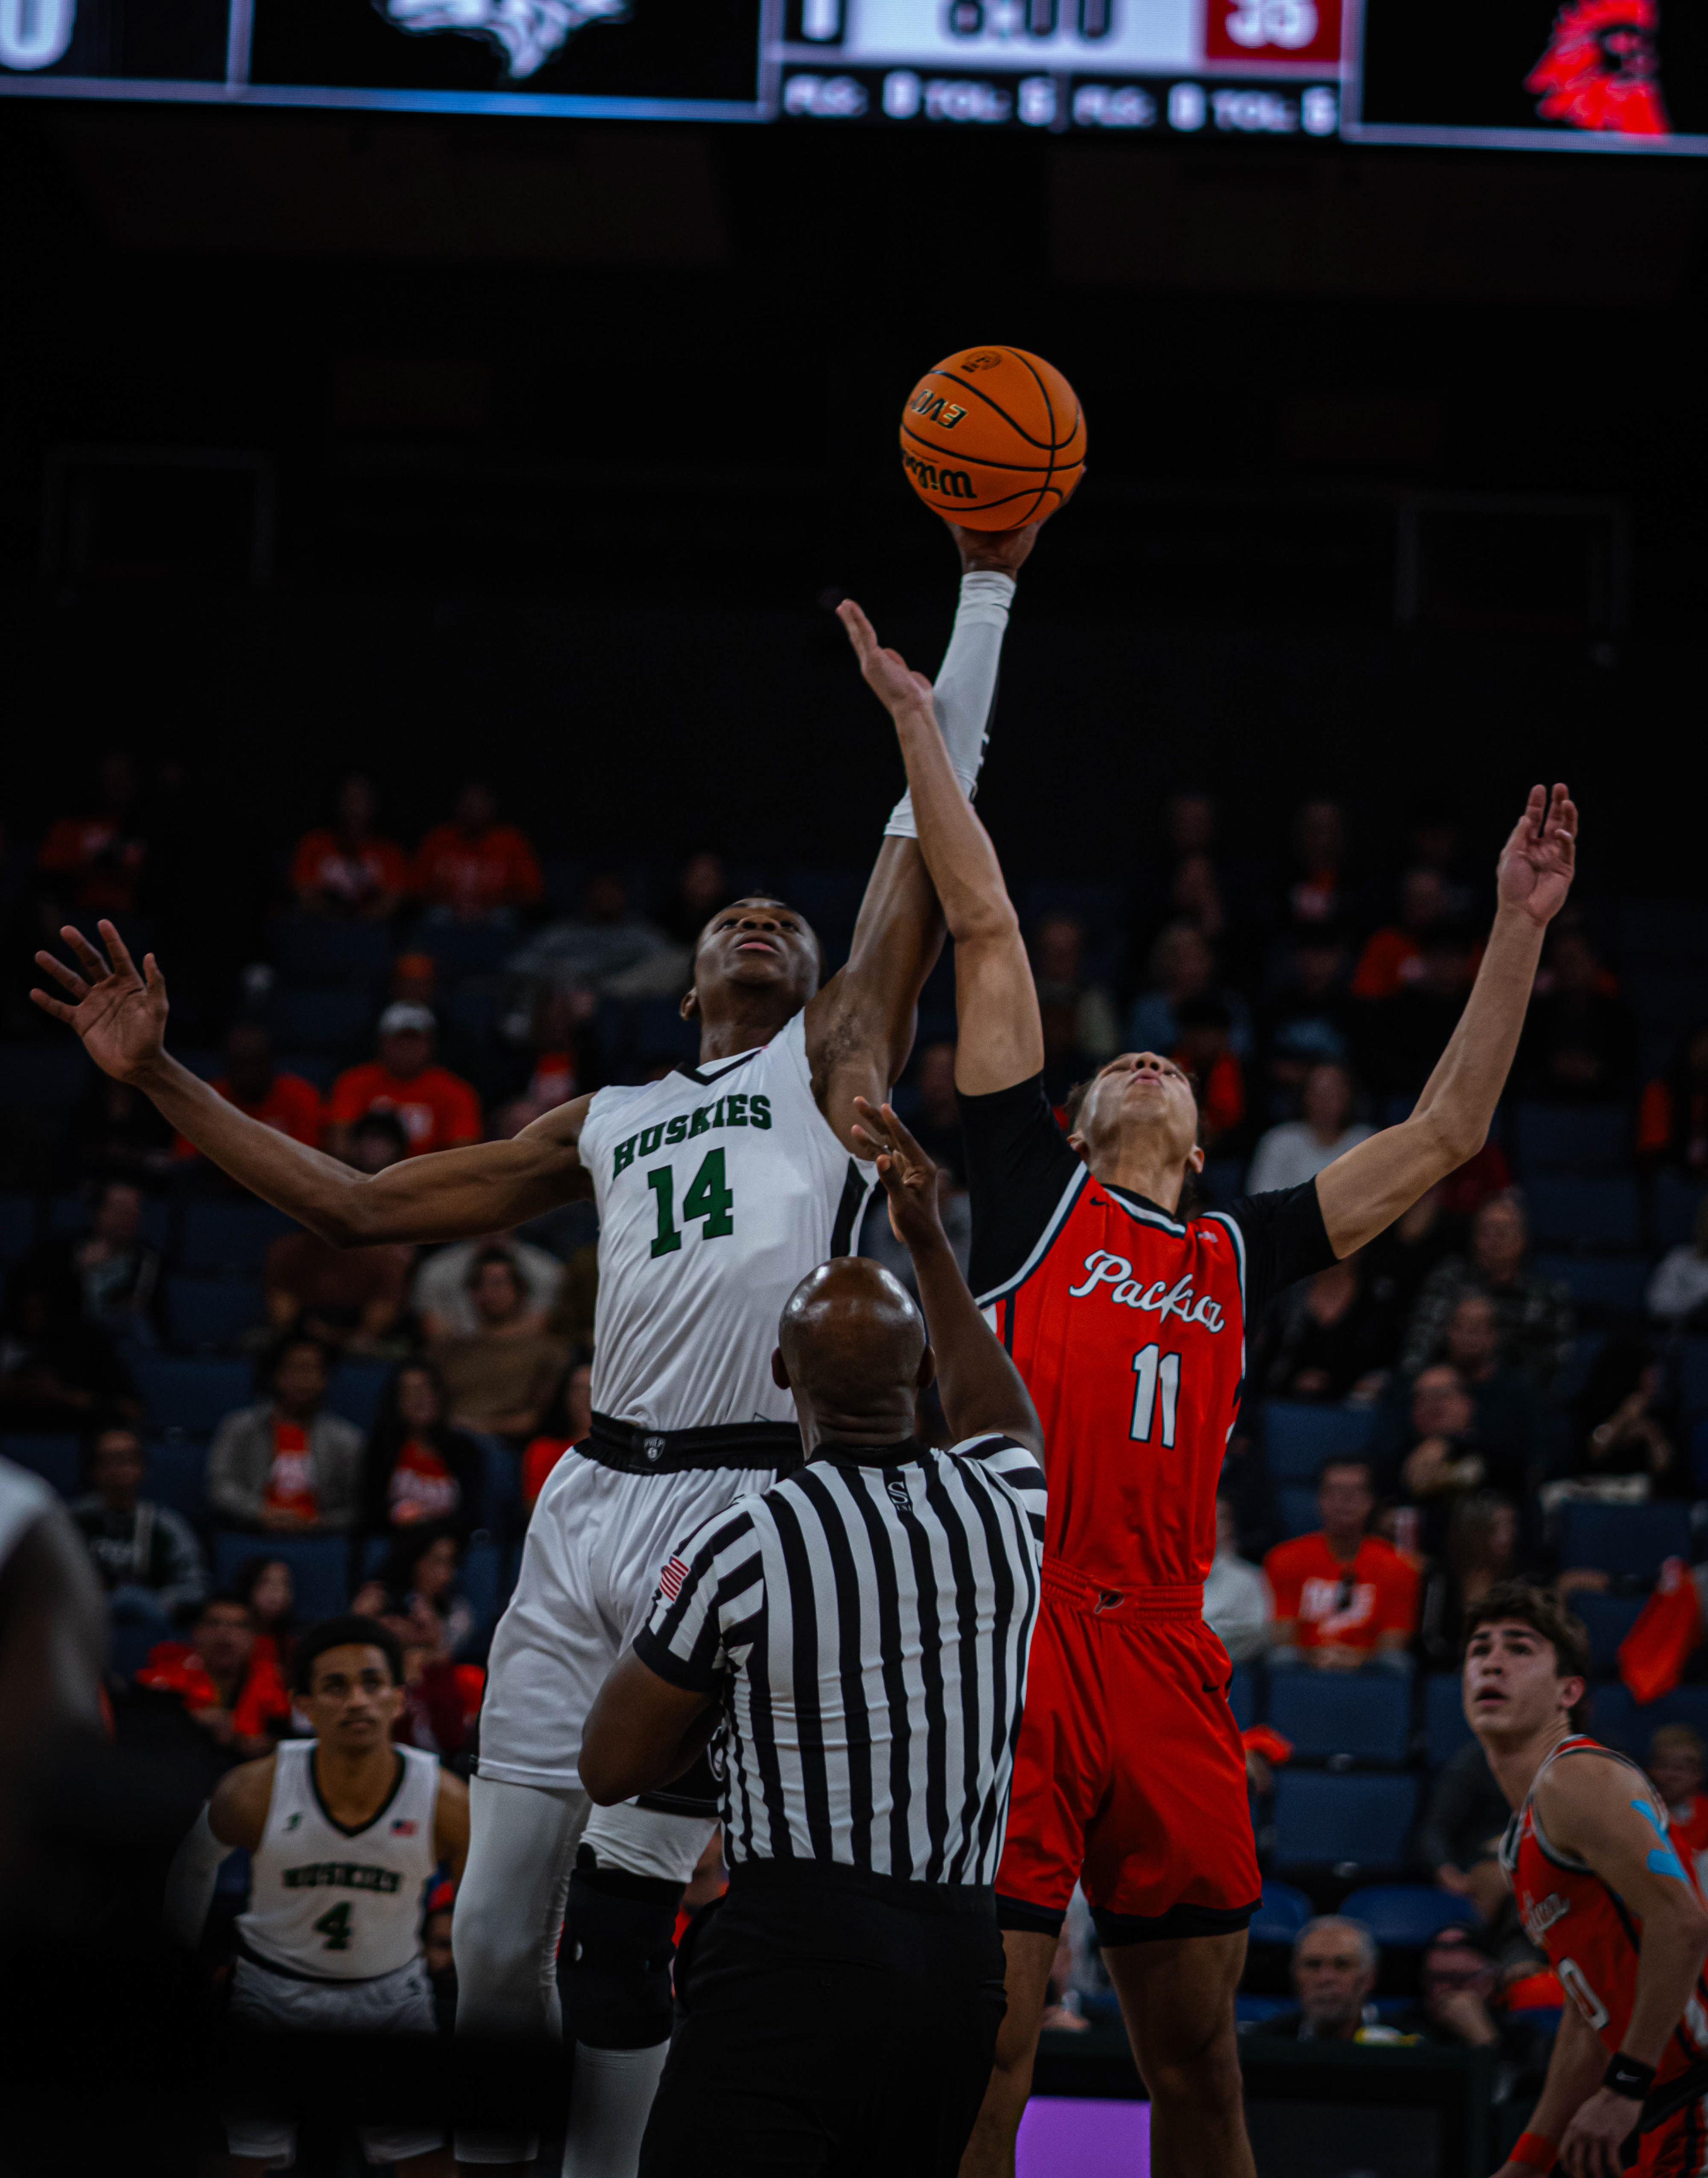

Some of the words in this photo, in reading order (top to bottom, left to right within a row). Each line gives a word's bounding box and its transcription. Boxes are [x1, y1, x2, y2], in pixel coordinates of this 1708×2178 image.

[613, 1093, 772, 1180] HUSKIES
[647, 1146, 733, 1259] 14
[1129, 1342, 1181, 1450] 11
[315, 1902, 350, 1950] 4
[1558, 1956, 1611, 2031] 0
